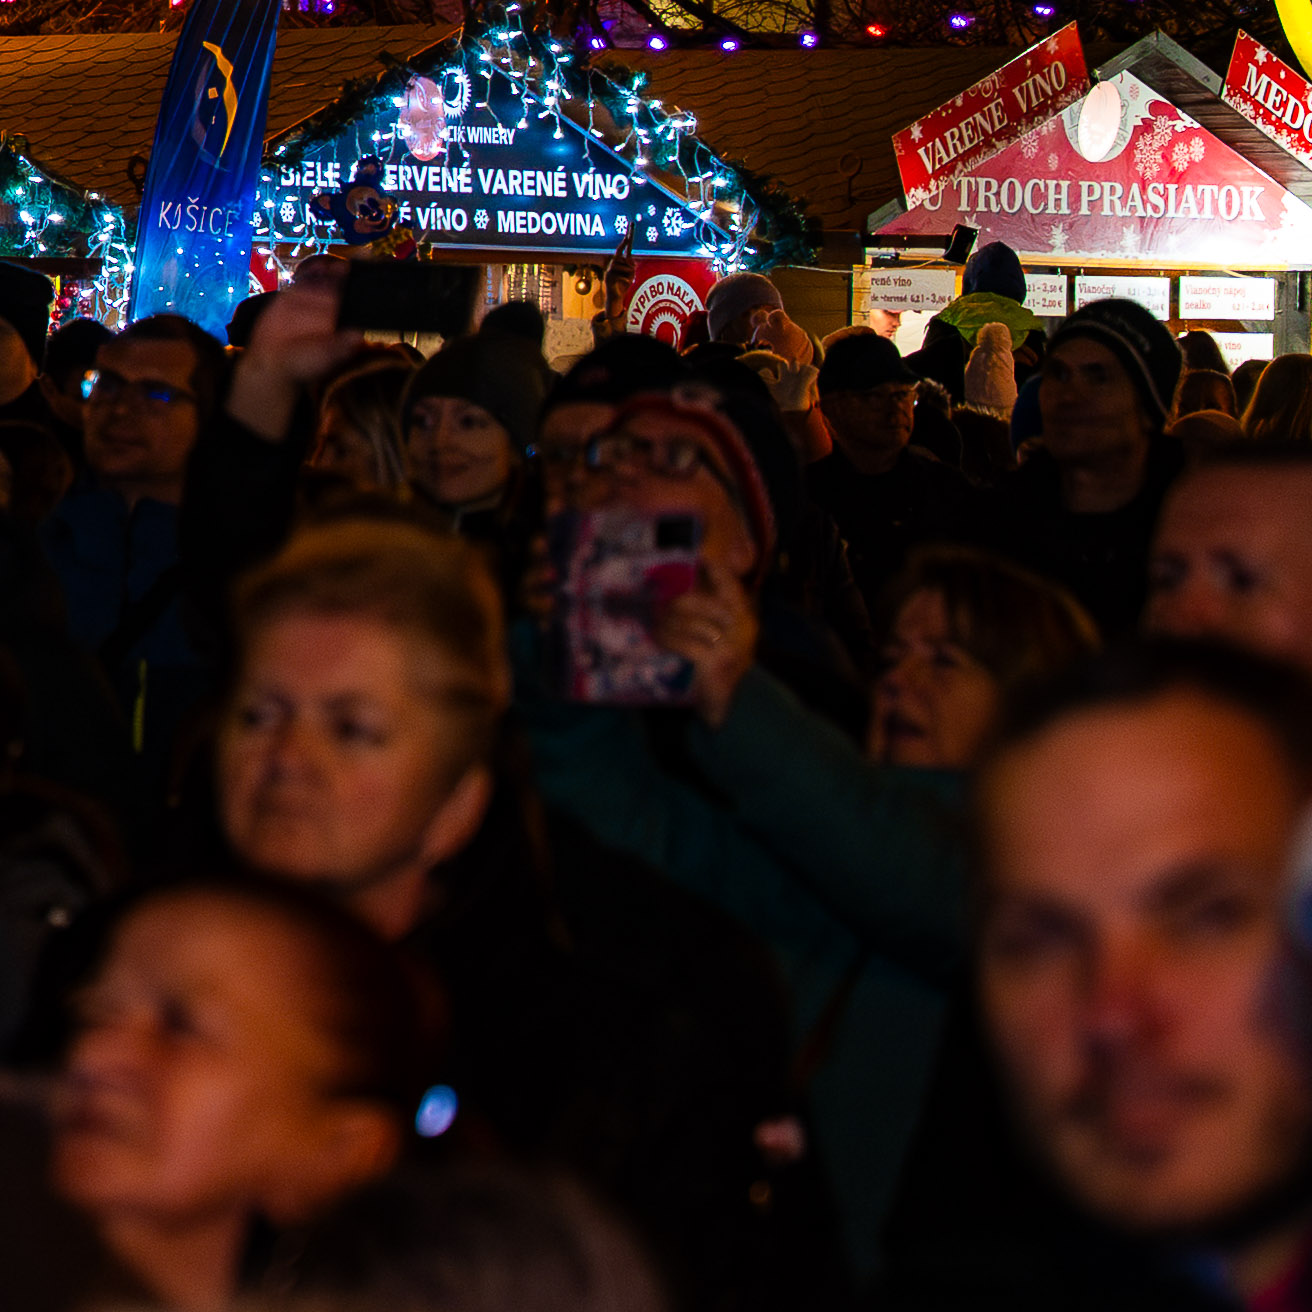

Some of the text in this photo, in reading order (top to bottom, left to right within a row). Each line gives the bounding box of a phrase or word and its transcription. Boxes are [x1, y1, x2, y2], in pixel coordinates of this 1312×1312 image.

[917, 60, 1067, 175] VARENÉ VÍNO
[467, 125, 516, 146] WINERY
[379, 157, 473, 194] ERVENÉ
[477, 165, 568, 198] VARENÉ
[571, 168, 631, 200] VÍNO
[953, 176, 1072, 215] TROCH
[1079, 180, 1267, 222] PRASIATOK
[417, 203, 468, 232] VÍNO
[497, 209, 606, 237] MEDOVINA
[892, 275, 913, 287] víno
[1078, 283, 1116, 296] Vianočný
[629, 290, 651, 326] VYPI
[649, 281, 665, 300] BO
[1184, 299, 1212, 310] nealko
